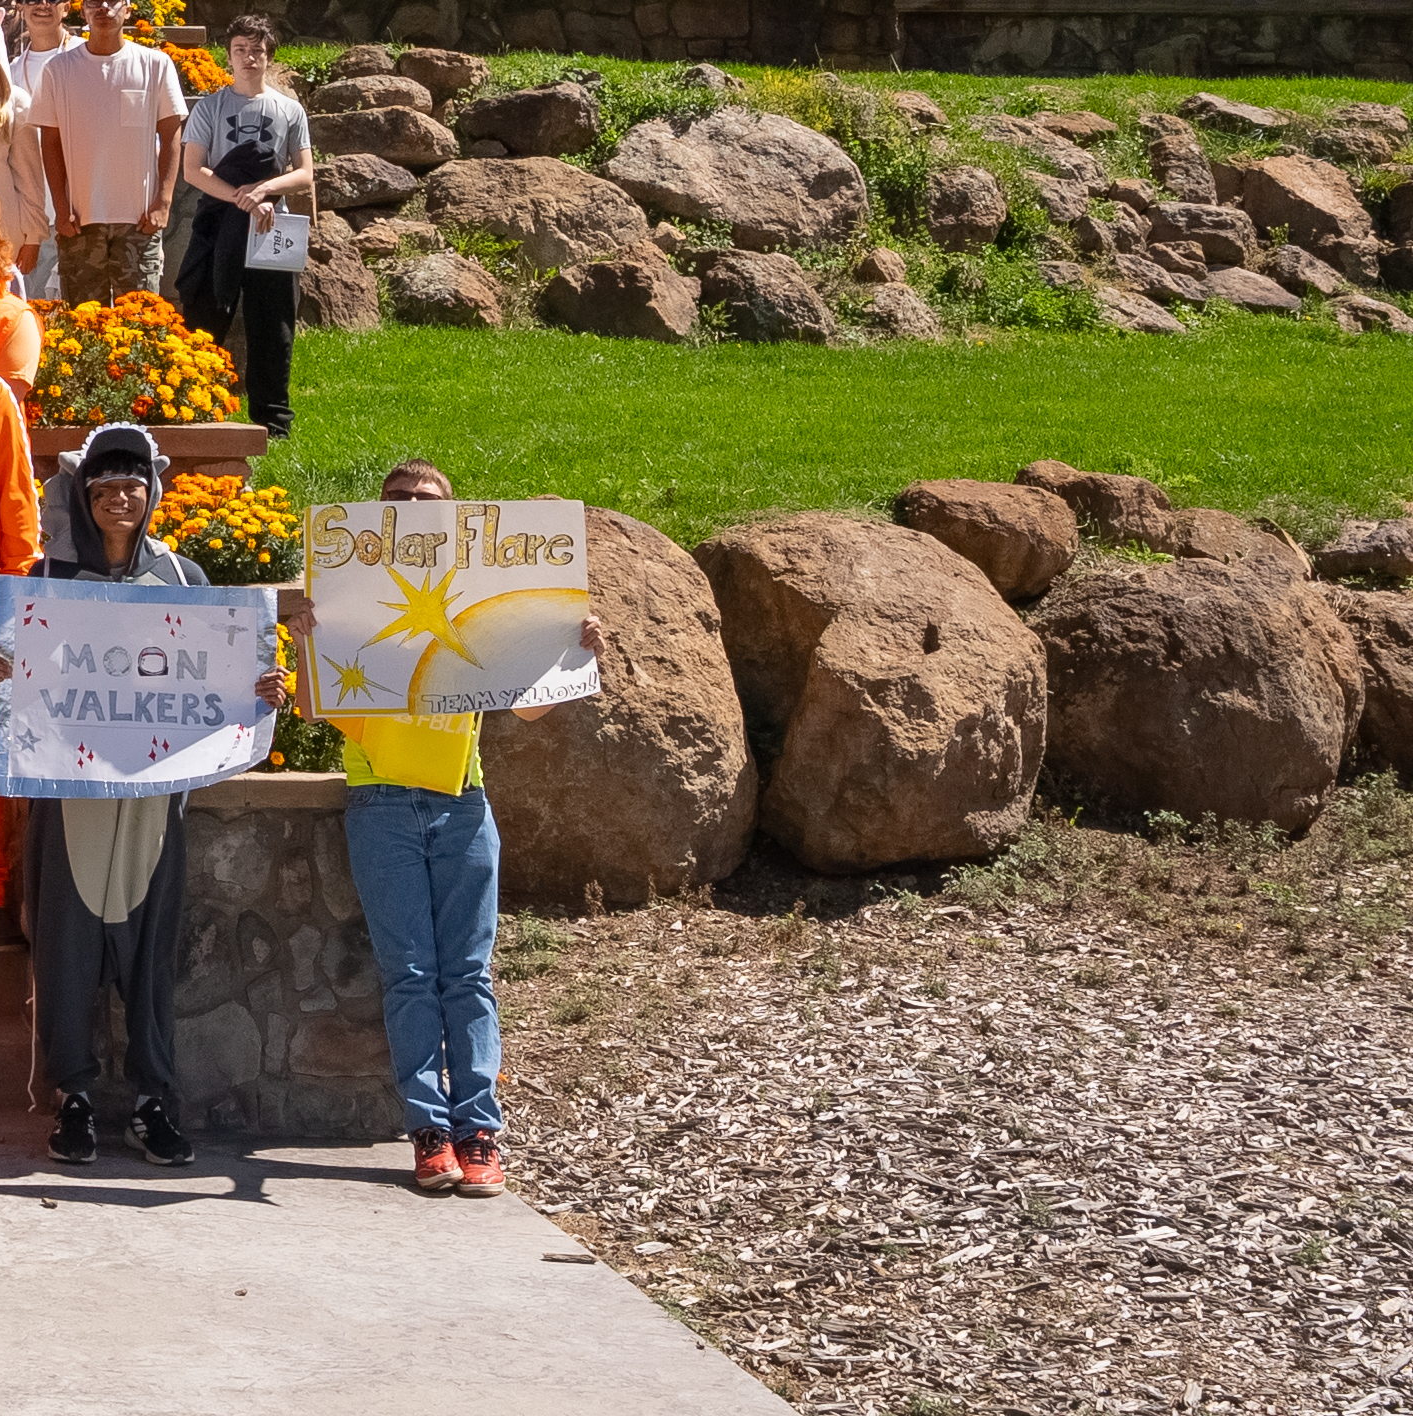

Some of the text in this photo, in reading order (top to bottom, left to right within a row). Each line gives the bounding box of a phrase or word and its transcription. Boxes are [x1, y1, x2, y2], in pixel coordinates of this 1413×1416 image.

[273, 229, 283, 255] FBLA
[311, 504, 575, 569] Solar Flare
[61, 643, 209, 681] MOON
[39, 688, 226, 727] WALKERS
[422, 672, 599, 714] TEAM YELLOW!
